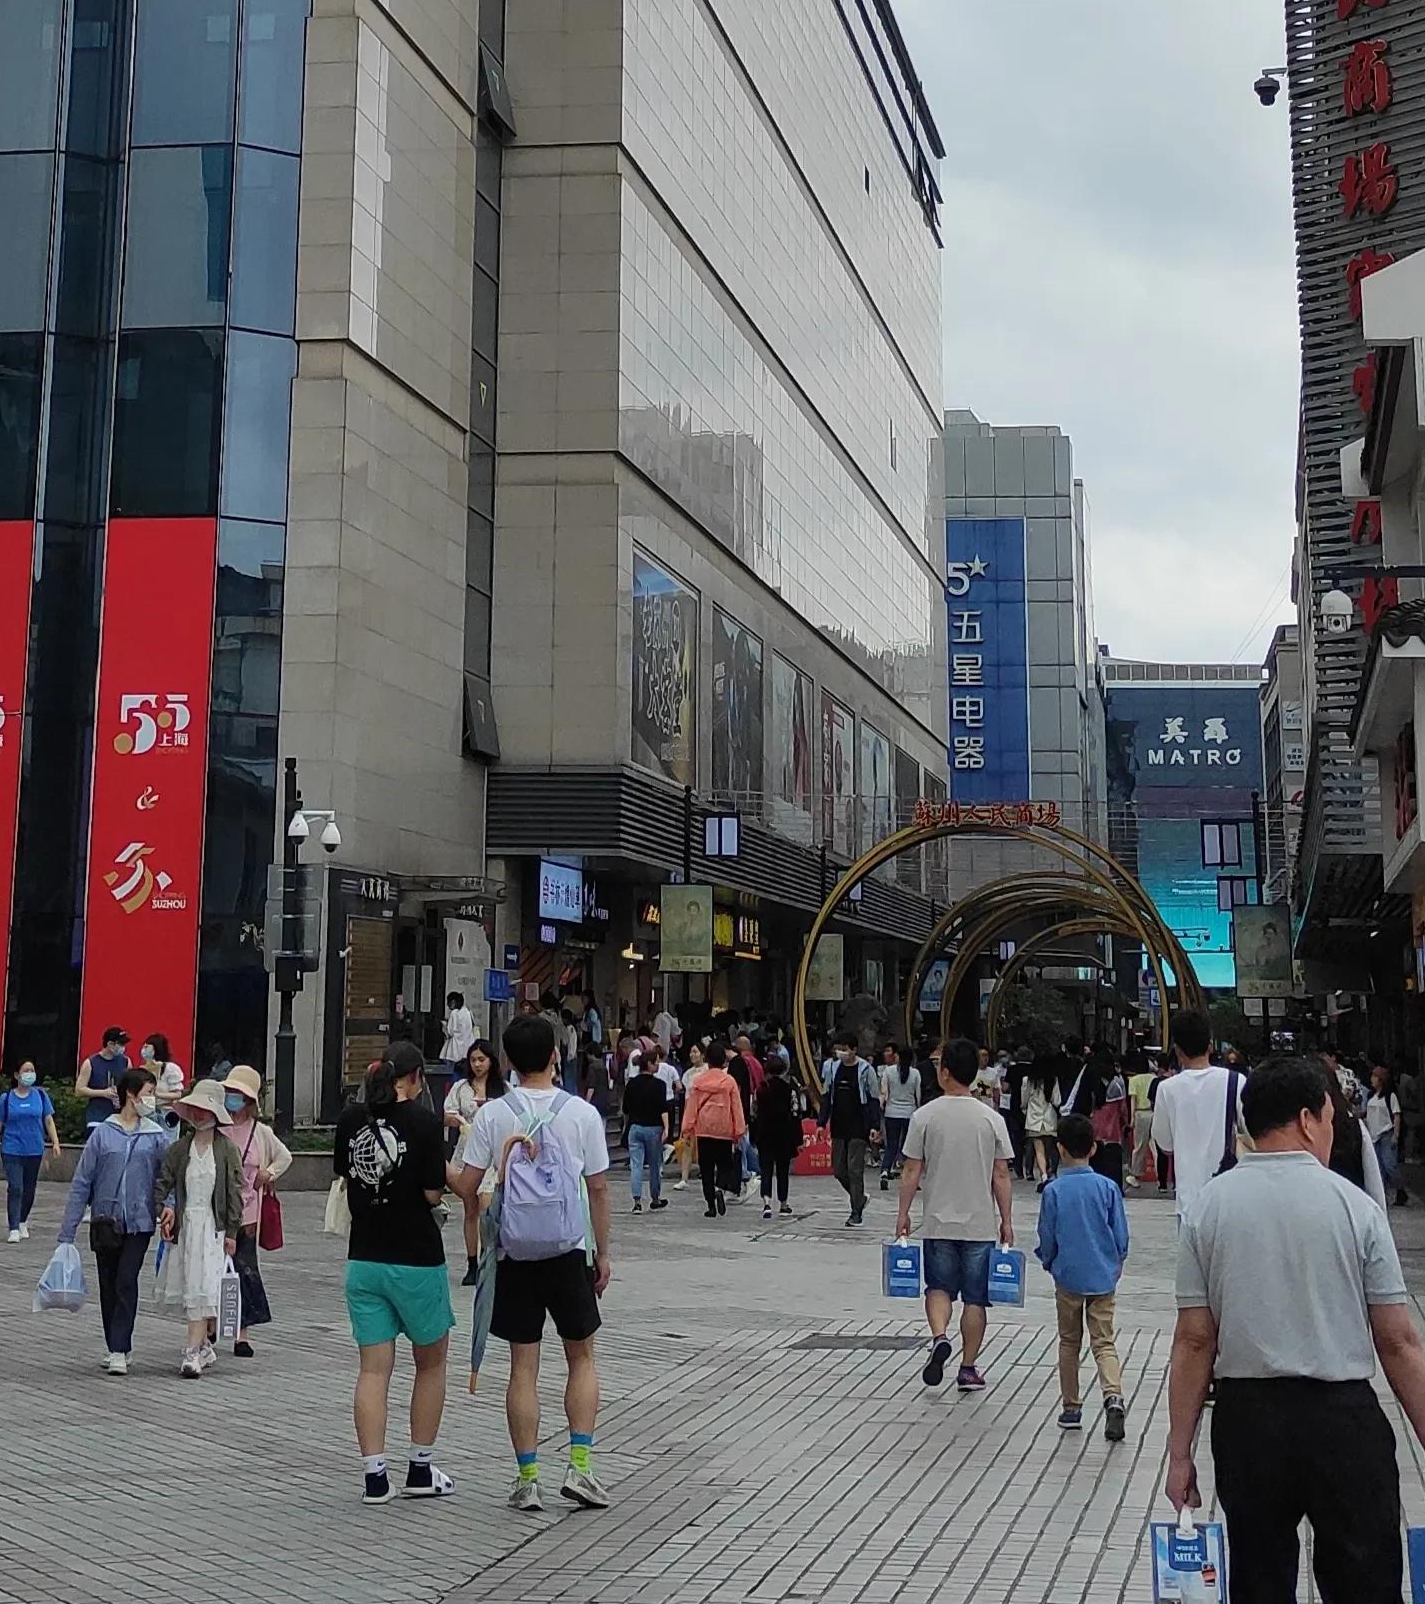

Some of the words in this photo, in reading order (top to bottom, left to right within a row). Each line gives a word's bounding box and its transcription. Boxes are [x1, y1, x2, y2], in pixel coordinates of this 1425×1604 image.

[952, 610, 985, 770] 五星电器
[1147, 748, 1242, 766] MATRO
[912, 798, 1062, 828] 蘇州人民商場
[1174, 1552, 1202, 1562] MILK
